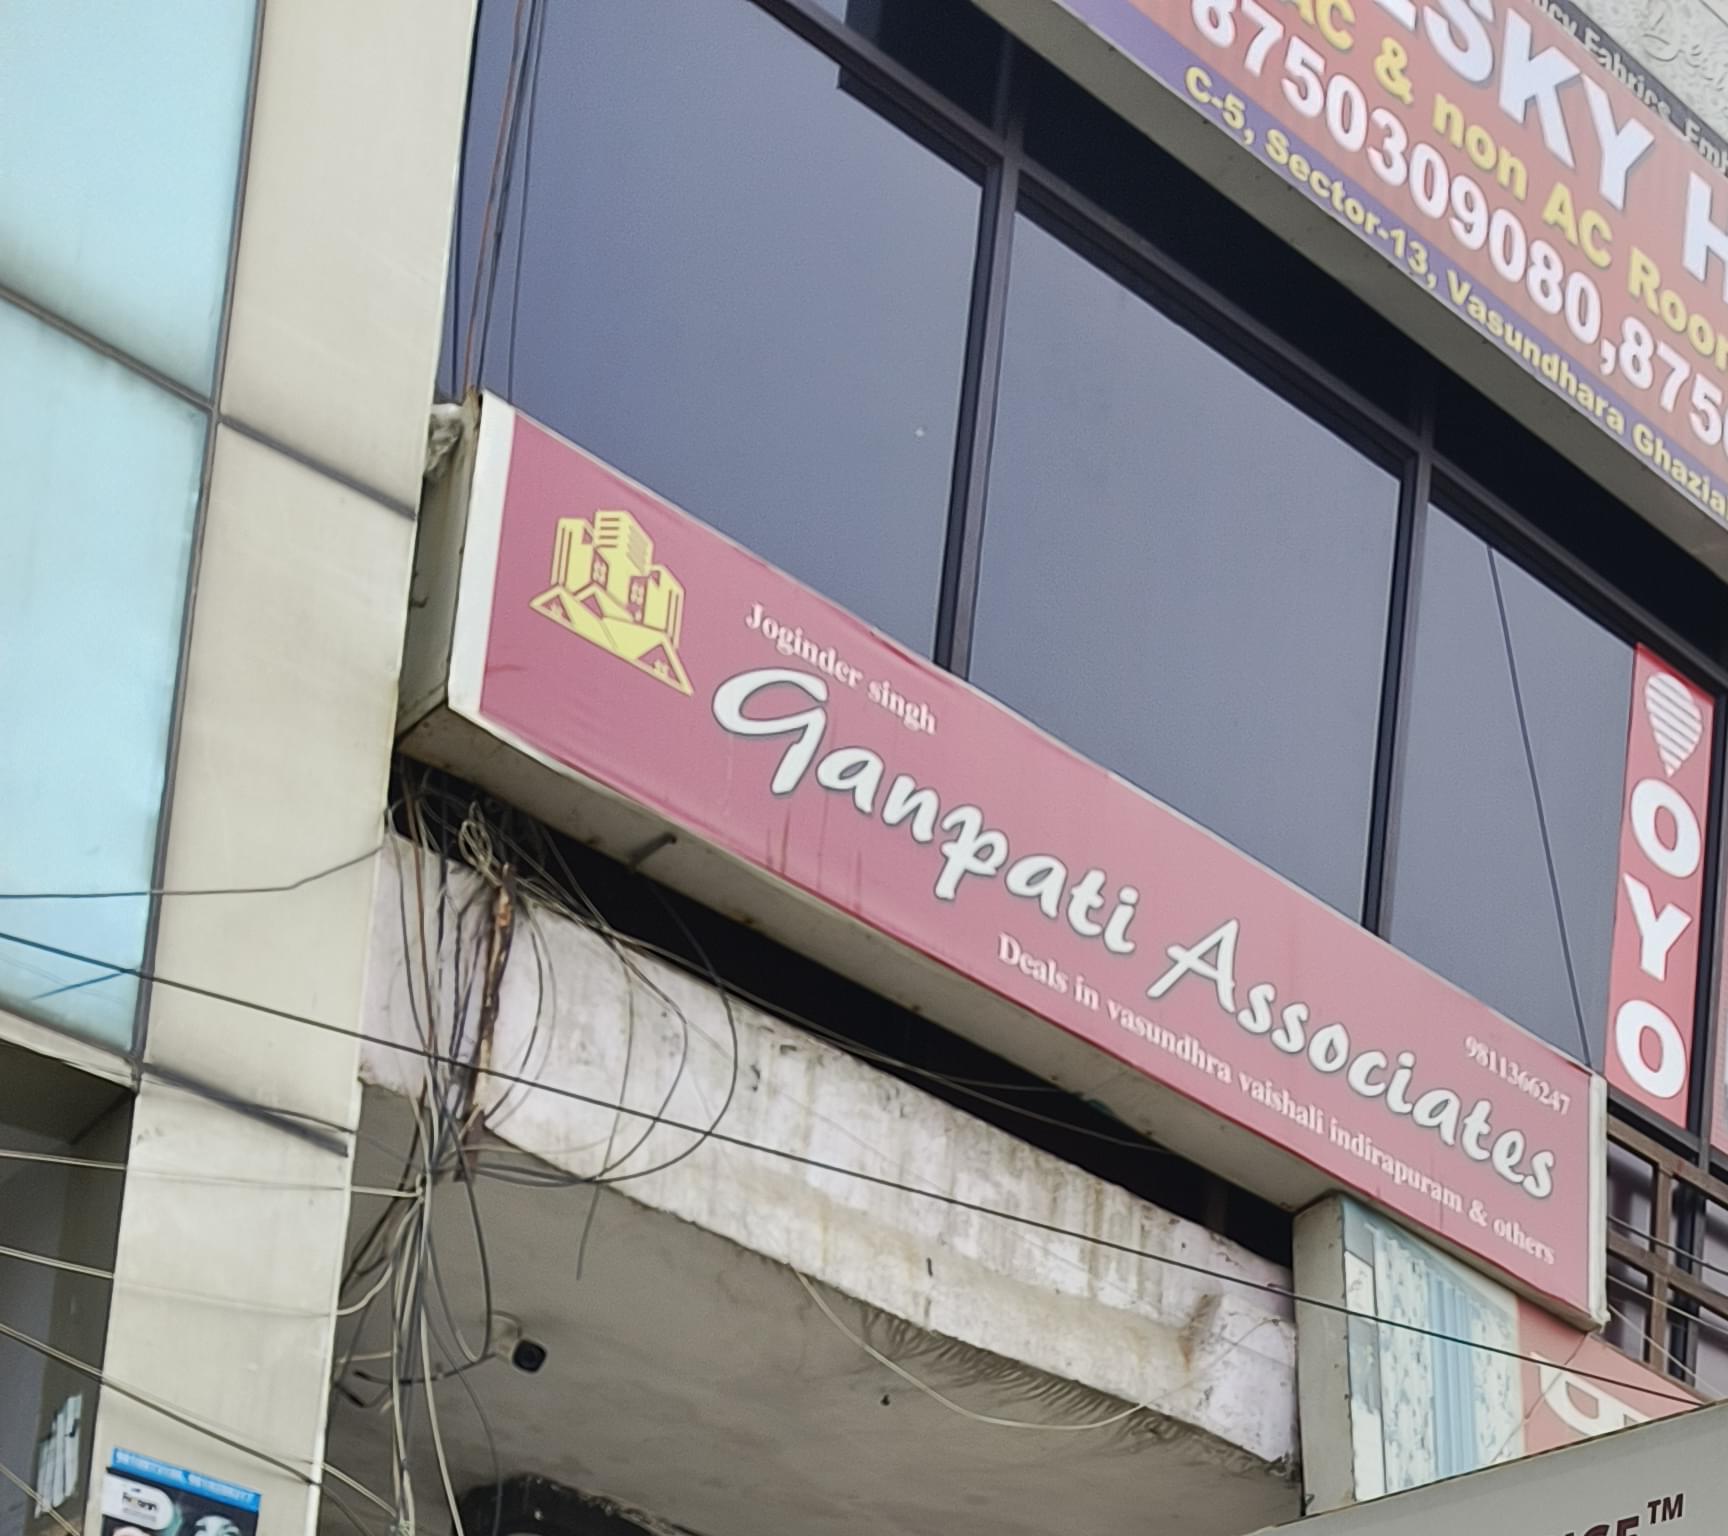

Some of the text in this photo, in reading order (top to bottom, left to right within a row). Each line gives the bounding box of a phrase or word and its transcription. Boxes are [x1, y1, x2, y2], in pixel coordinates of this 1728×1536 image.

[1184, 65, 1257, 146] C-5,
[1265, 128, 1438, 290] Sector-13,
[1446, 268, 1626, 437] Vasundhara
[1372, 0, 1656, 213] SKY
[1373, 36, 1415, 105] &
[1433, 93, 1529, 201] non
[1541, 181, 1615, 271] AC
[745, 600, 938, 736] Joginder singh
[711, 666, 1558, 1202] Ganpati Associates
[1613, 776, 1702, 1100] OYO
[997, 931, 1558, 1267] Deals in vasundhra vaishali indirapuram & others
